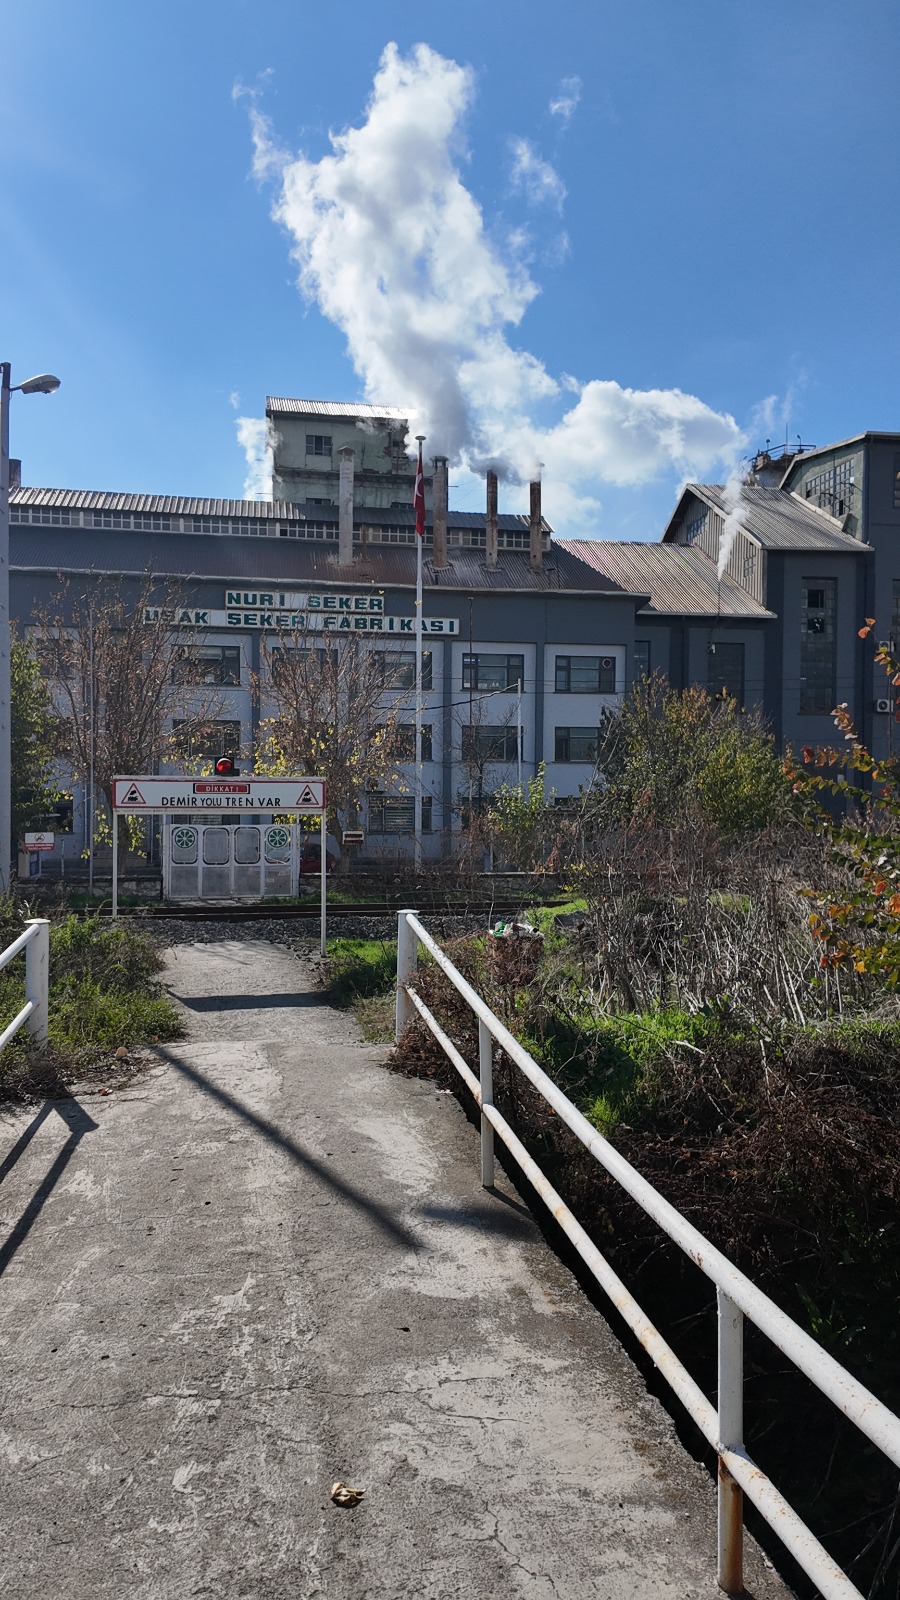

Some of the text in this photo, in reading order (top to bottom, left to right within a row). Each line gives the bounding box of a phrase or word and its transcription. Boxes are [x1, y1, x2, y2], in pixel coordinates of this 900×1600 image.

[161, 794, 281, 807] DEMİR YOLU TREN VAR
